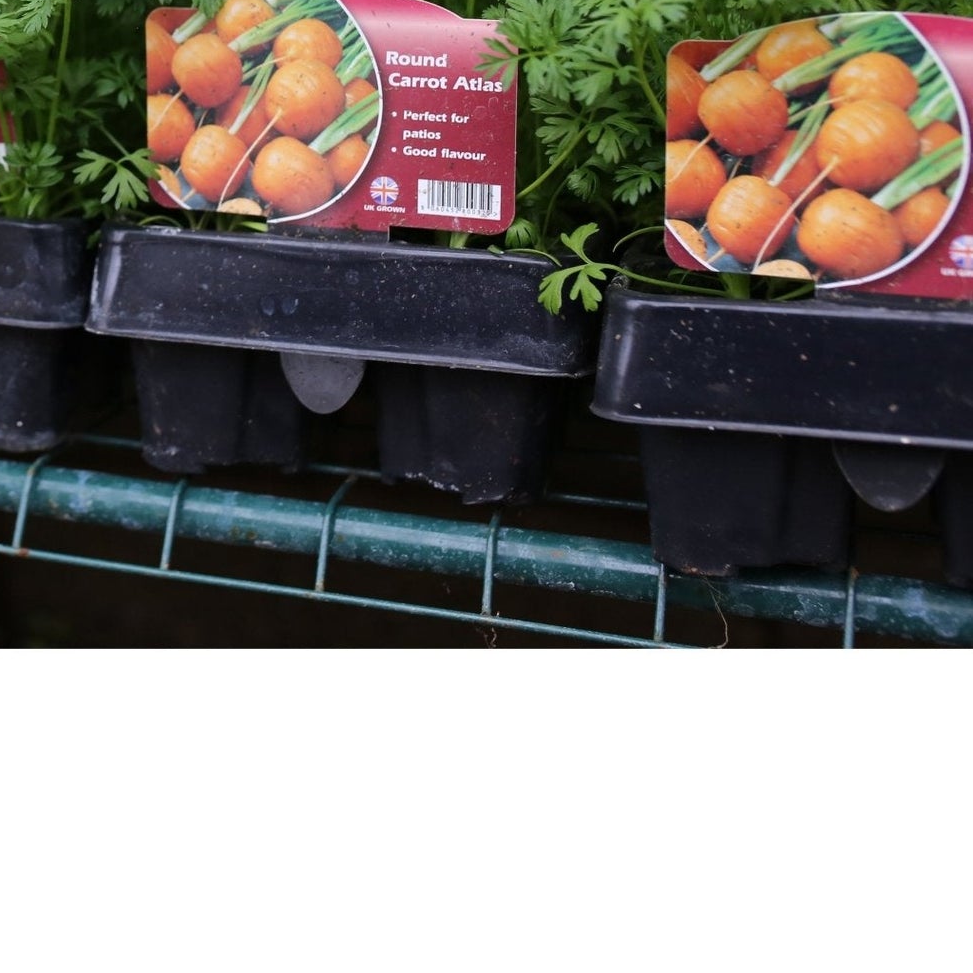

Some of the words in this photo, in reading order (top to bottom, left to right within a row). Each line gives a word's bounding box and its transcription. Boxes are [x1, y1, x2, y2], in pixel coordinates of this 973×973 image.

[386, 50, 447, 68] Round
[388, 72, 448, 90] Carrot
[453, 76, 504, 93] Atlas
[403, 110, 447, 123] Perfect
[451, 113, 470, 124] for
[403, 129, 441, 141] patios
[403, 146, 437, 158] Good
[441, 148, 486, 161] flavour
[363, 204, 375, 212] UK
[376, 205, 406, 214] GROWN
